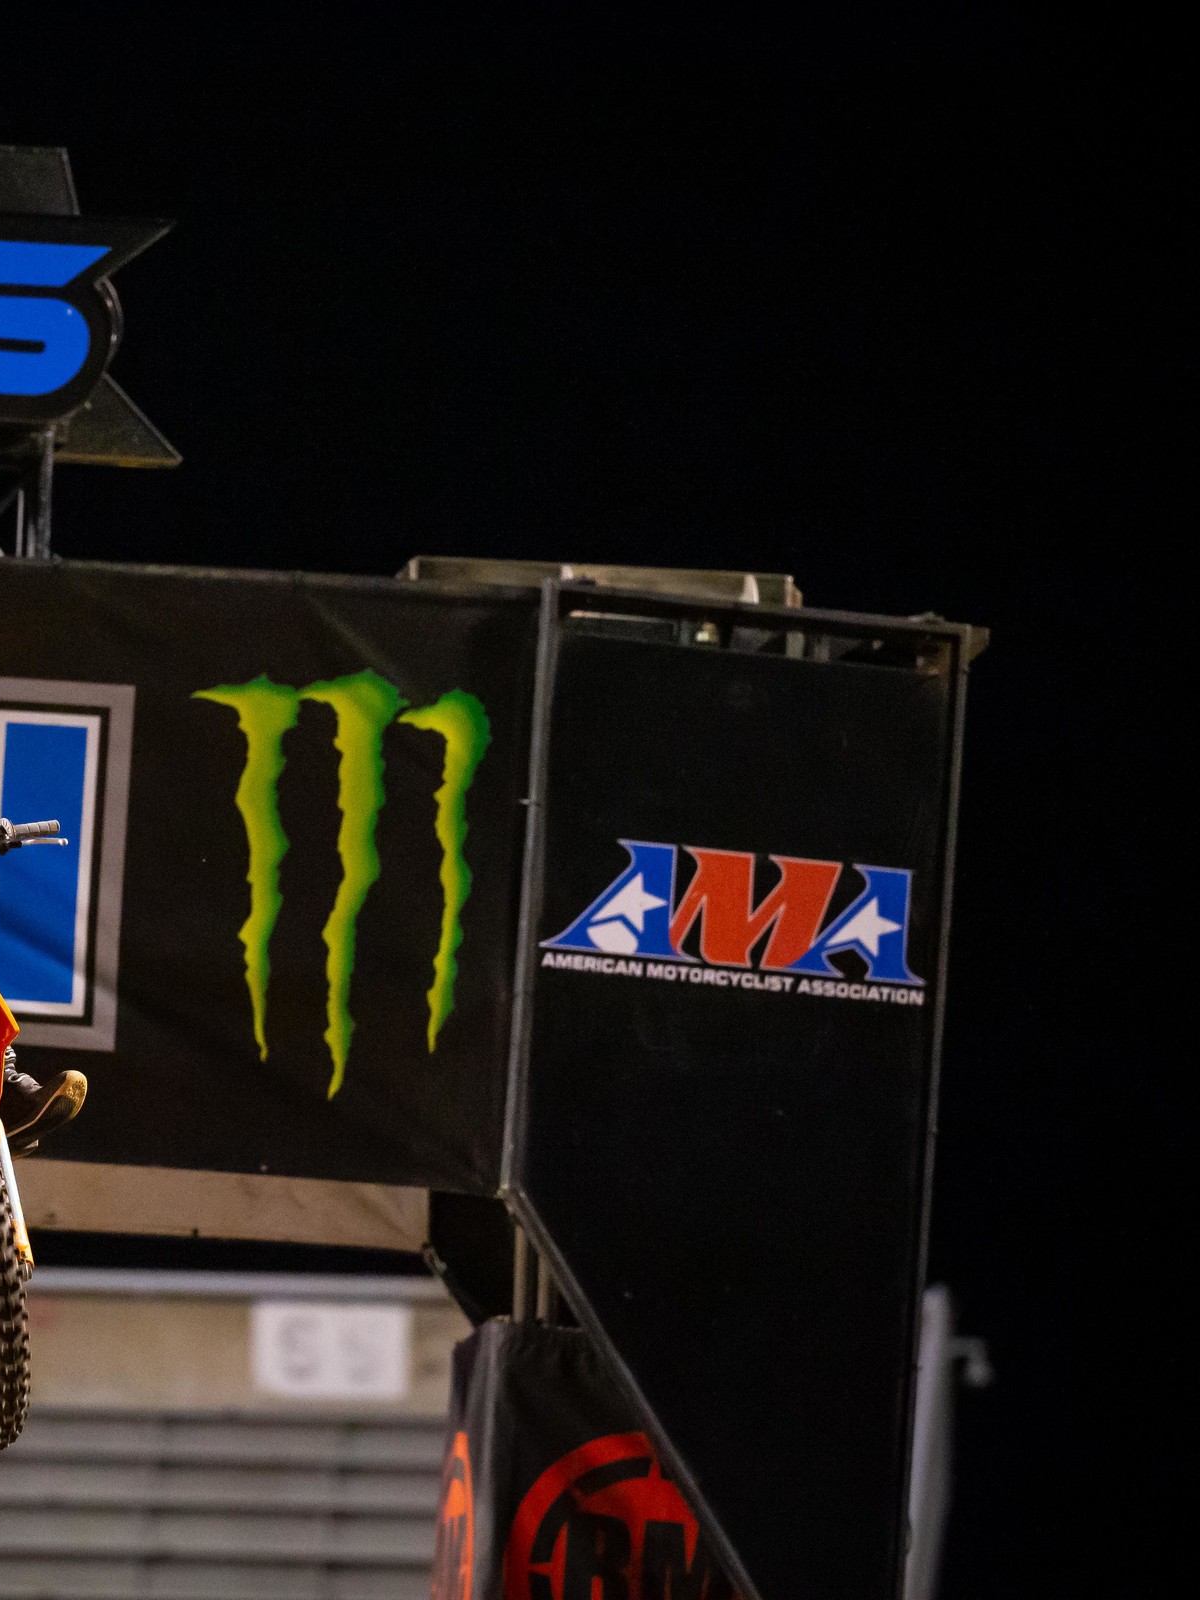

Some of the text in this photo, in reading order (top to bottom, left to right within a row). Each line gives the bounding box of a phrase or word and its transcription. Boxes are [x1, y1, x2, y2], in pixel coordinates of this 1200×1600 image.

[538, 838, 926, 986] AMA
[540, 951, 926, 1006] AMERICAN MOTORCYCLIST ASSOCIATION
